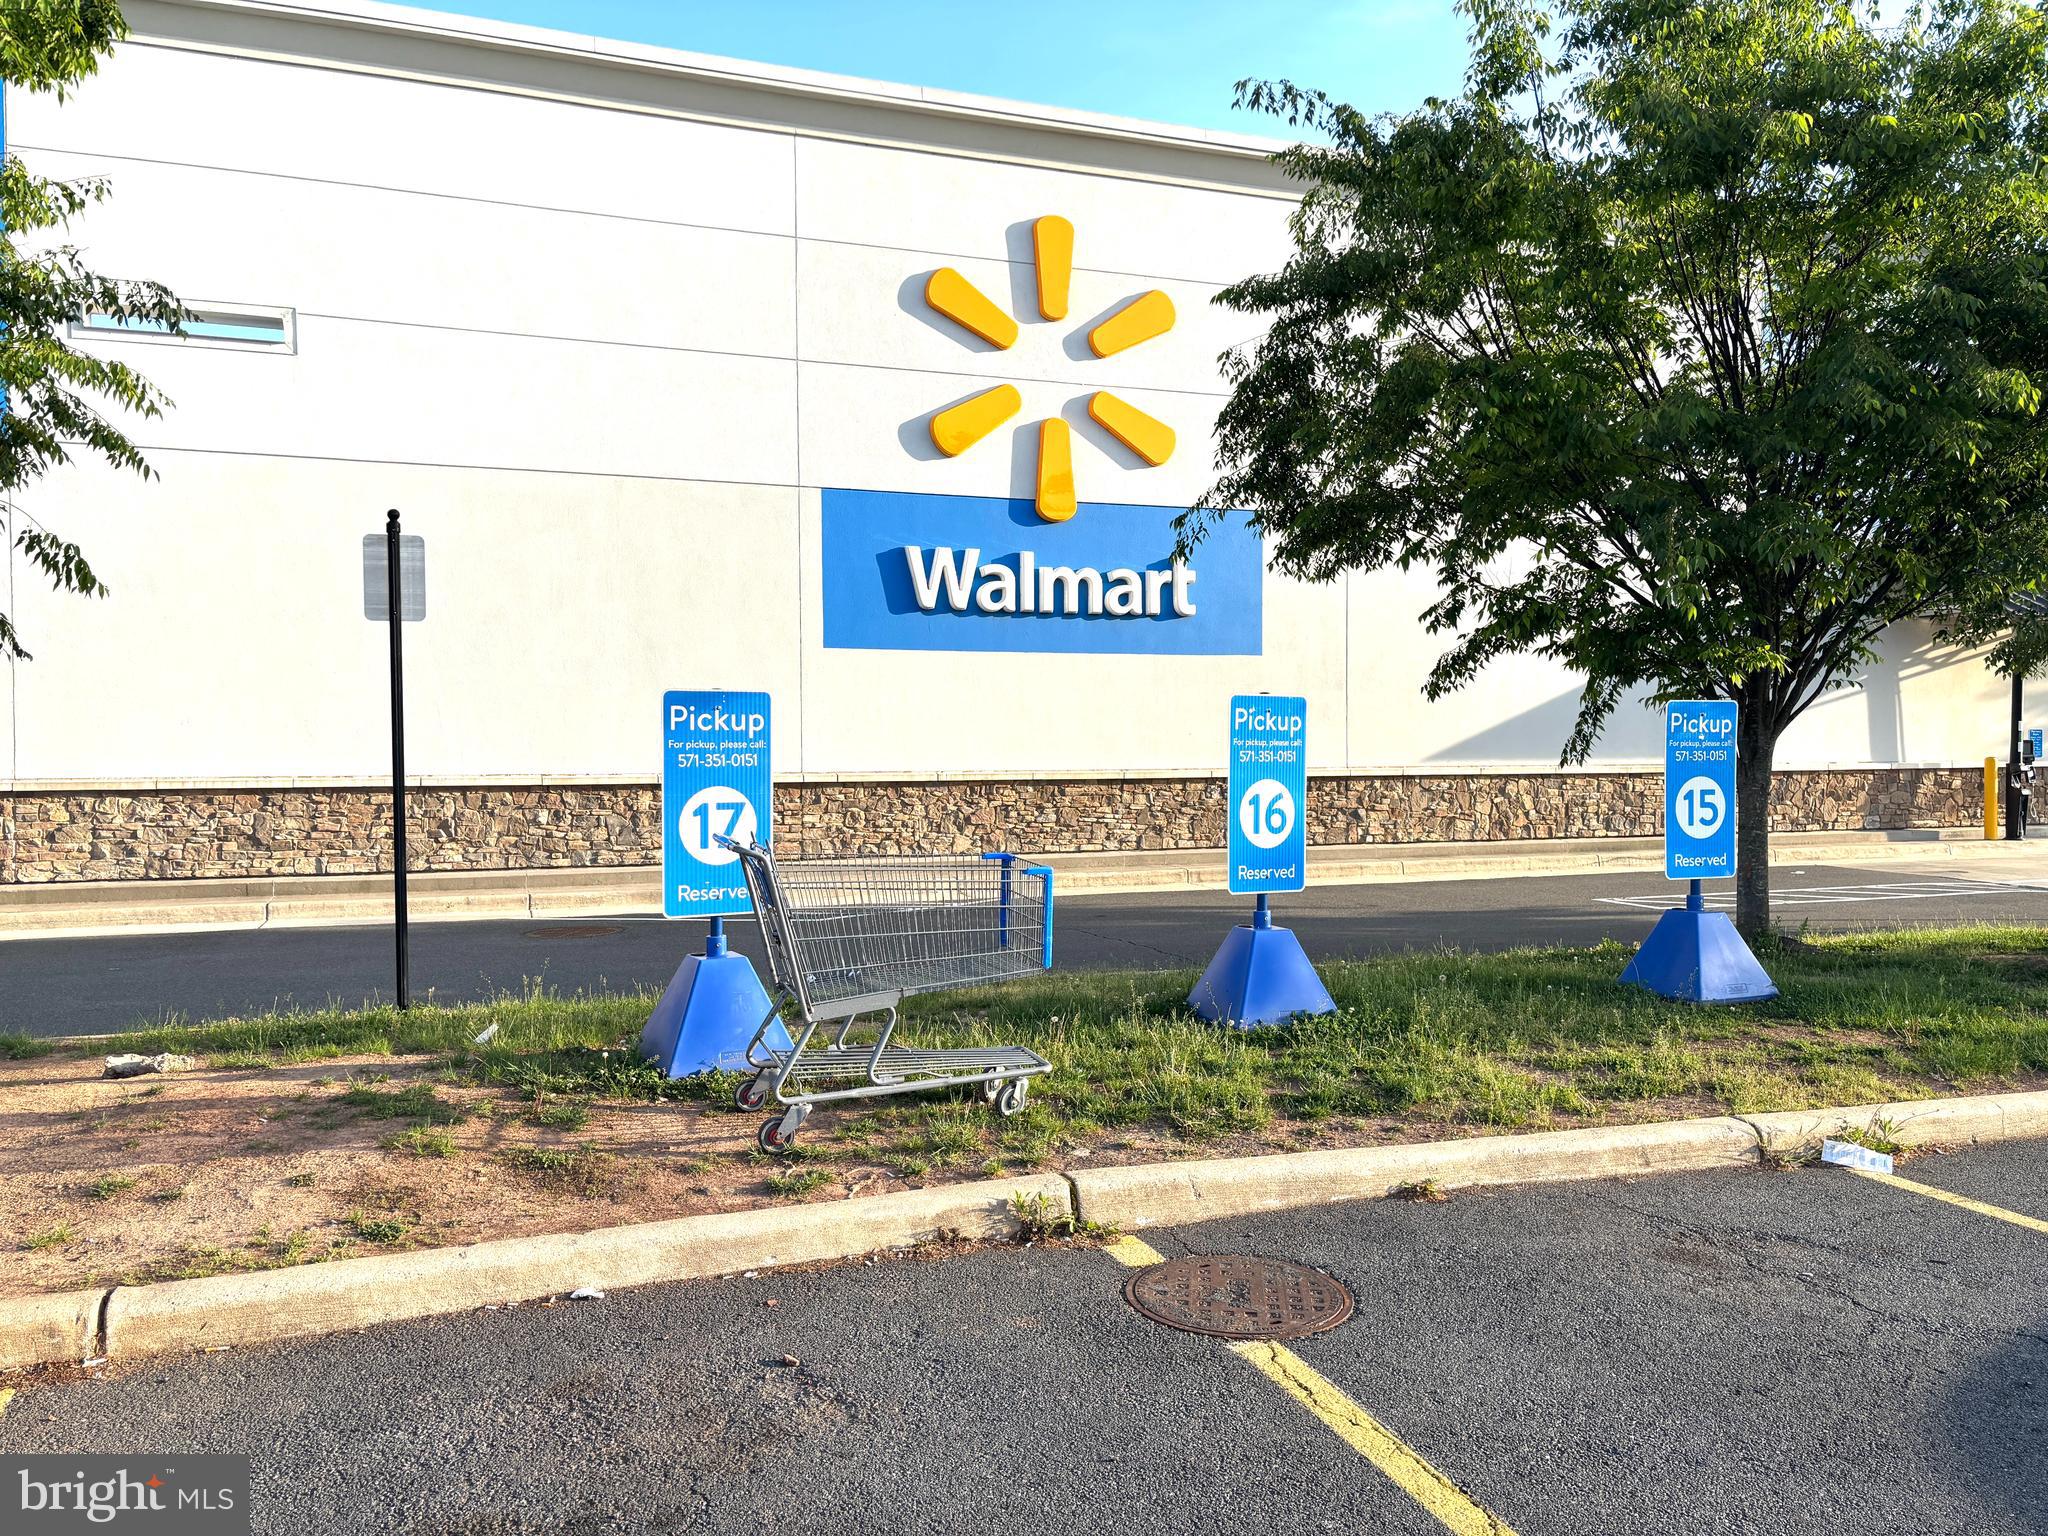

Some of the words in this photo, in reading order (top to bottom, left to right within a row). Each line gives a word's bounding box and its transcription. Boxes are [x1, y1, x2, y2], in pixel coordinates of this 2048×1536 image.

[904, 545, 1197, 617] Walmart
[670, 705, 765, 738] Pickup
[1234, 707, 1302, 737] Pickup
[1670, 713, 1732, 738] Pickup
[668, 740, 684, 748] For
[686, 740, 718, 750] pickup,
[720, 740, 747, 750] please
[749, 740, 767, 749] call:
[1233, 738, 1244, 746] For
[1269, 739, 1290, 748] please
[1702, 740, 1721, 748] please
[678, 753, 758, 767] 571-351-0151
[1239, 750, 1297, 762] 571-351-0151
[1675, 750, 1727, 761] 571-351-0151
[1248, 793, 1287, 835] 16
[1683, 789, 1719, 826] 15
[692, 802, 746, 849] 17
[1675, 853, 1727, 867] Reserved
[1238, 864, 1295, 880] Reserved
[678, 884, 750, 902] Reserve
